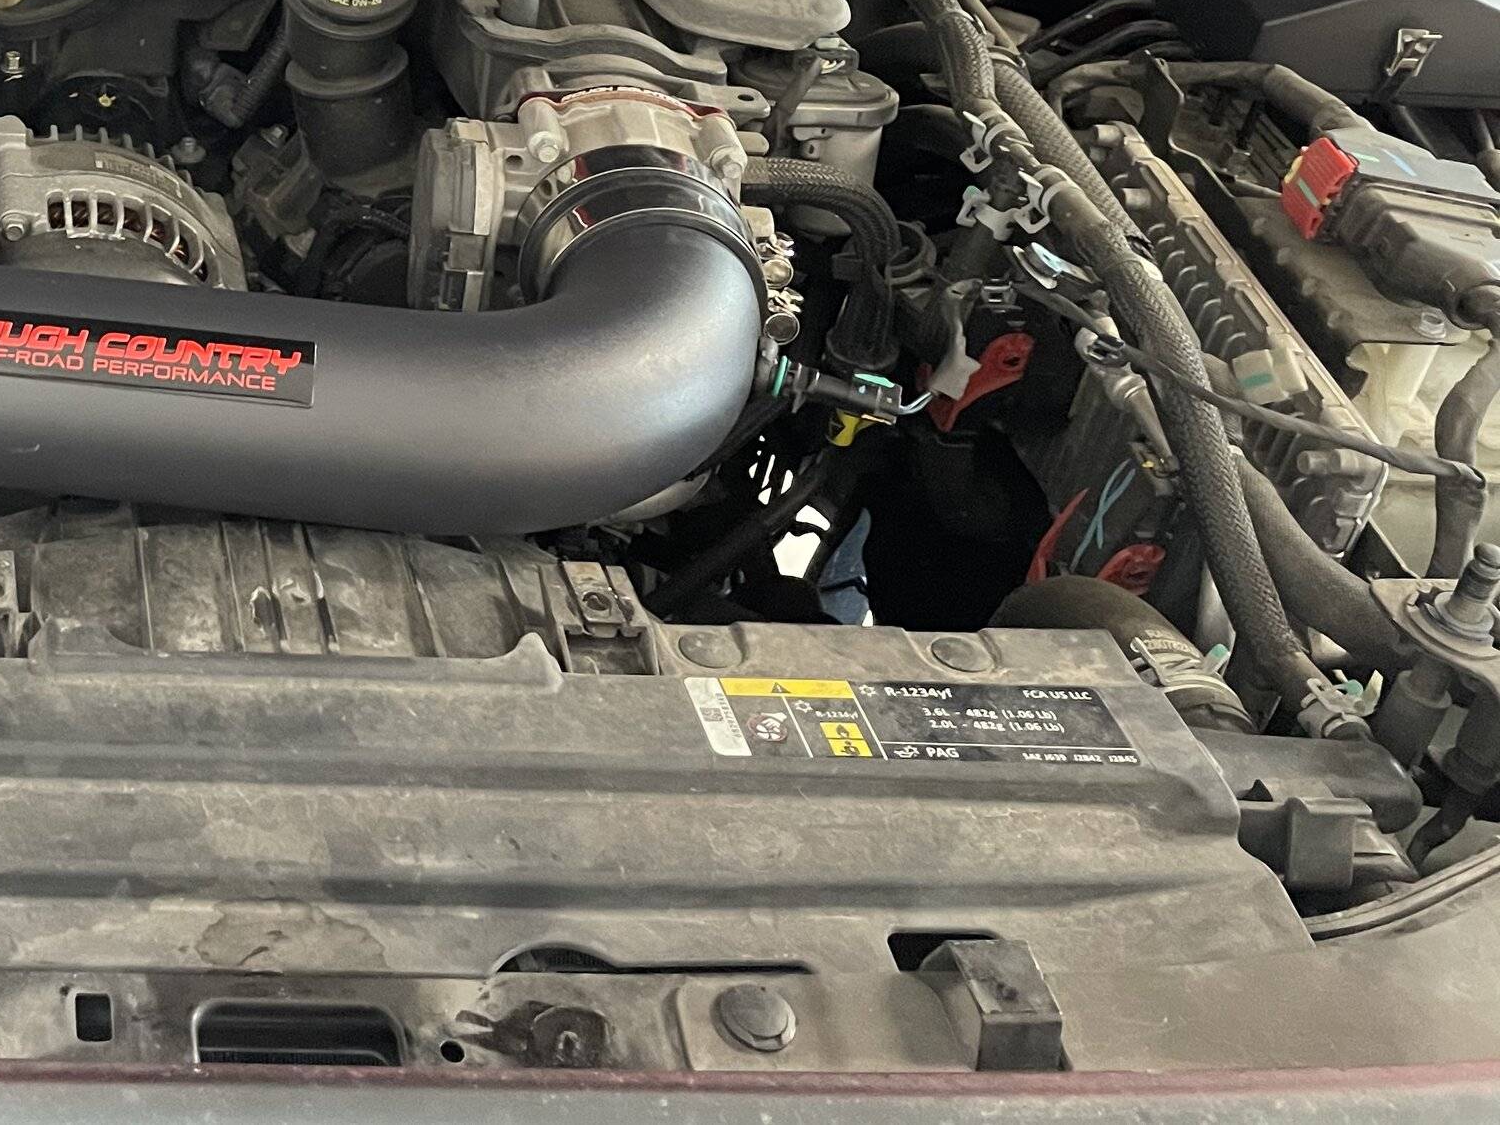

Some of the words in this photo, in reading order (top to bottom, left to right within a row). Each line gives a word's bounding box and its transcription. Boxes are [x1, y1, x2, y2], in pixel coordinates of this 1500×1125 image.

[95, 331, 302, 375] COUNTRY
[92, 358, 277, 392] PERFORMANCE
[883, 685, 954, 700] R-1234yf
[1022, 689, 1049, 699] FCA
[1048, 690, 1068, 700] US
[1068, 691, 1093, 701] LLC
[921, 707, 950, 717] 3.6L
[928, 720, 958, 729] 2.0L
[925, 746, 961, 759] PAG
